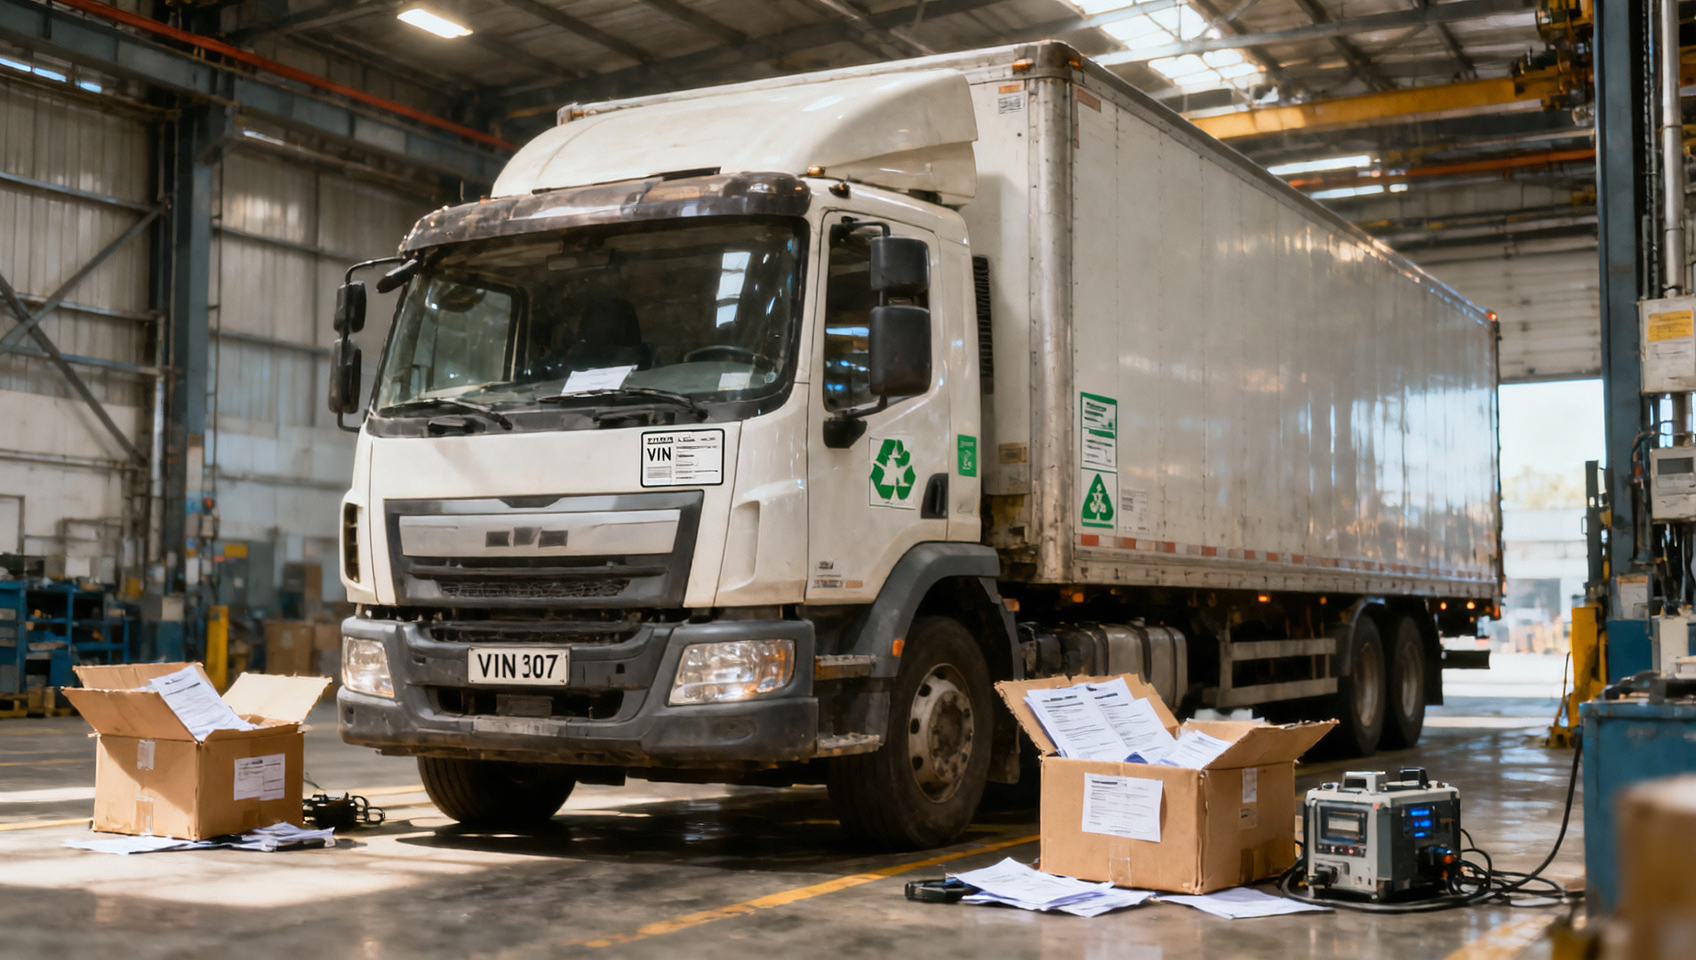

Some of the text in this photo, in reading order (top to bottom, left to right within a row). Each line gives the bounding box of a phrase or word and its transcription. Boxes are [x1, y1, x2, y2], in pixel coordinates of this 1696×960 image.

[647, 446, 672, 462] VIN
[477, 653, 559, 679] VIN 307
